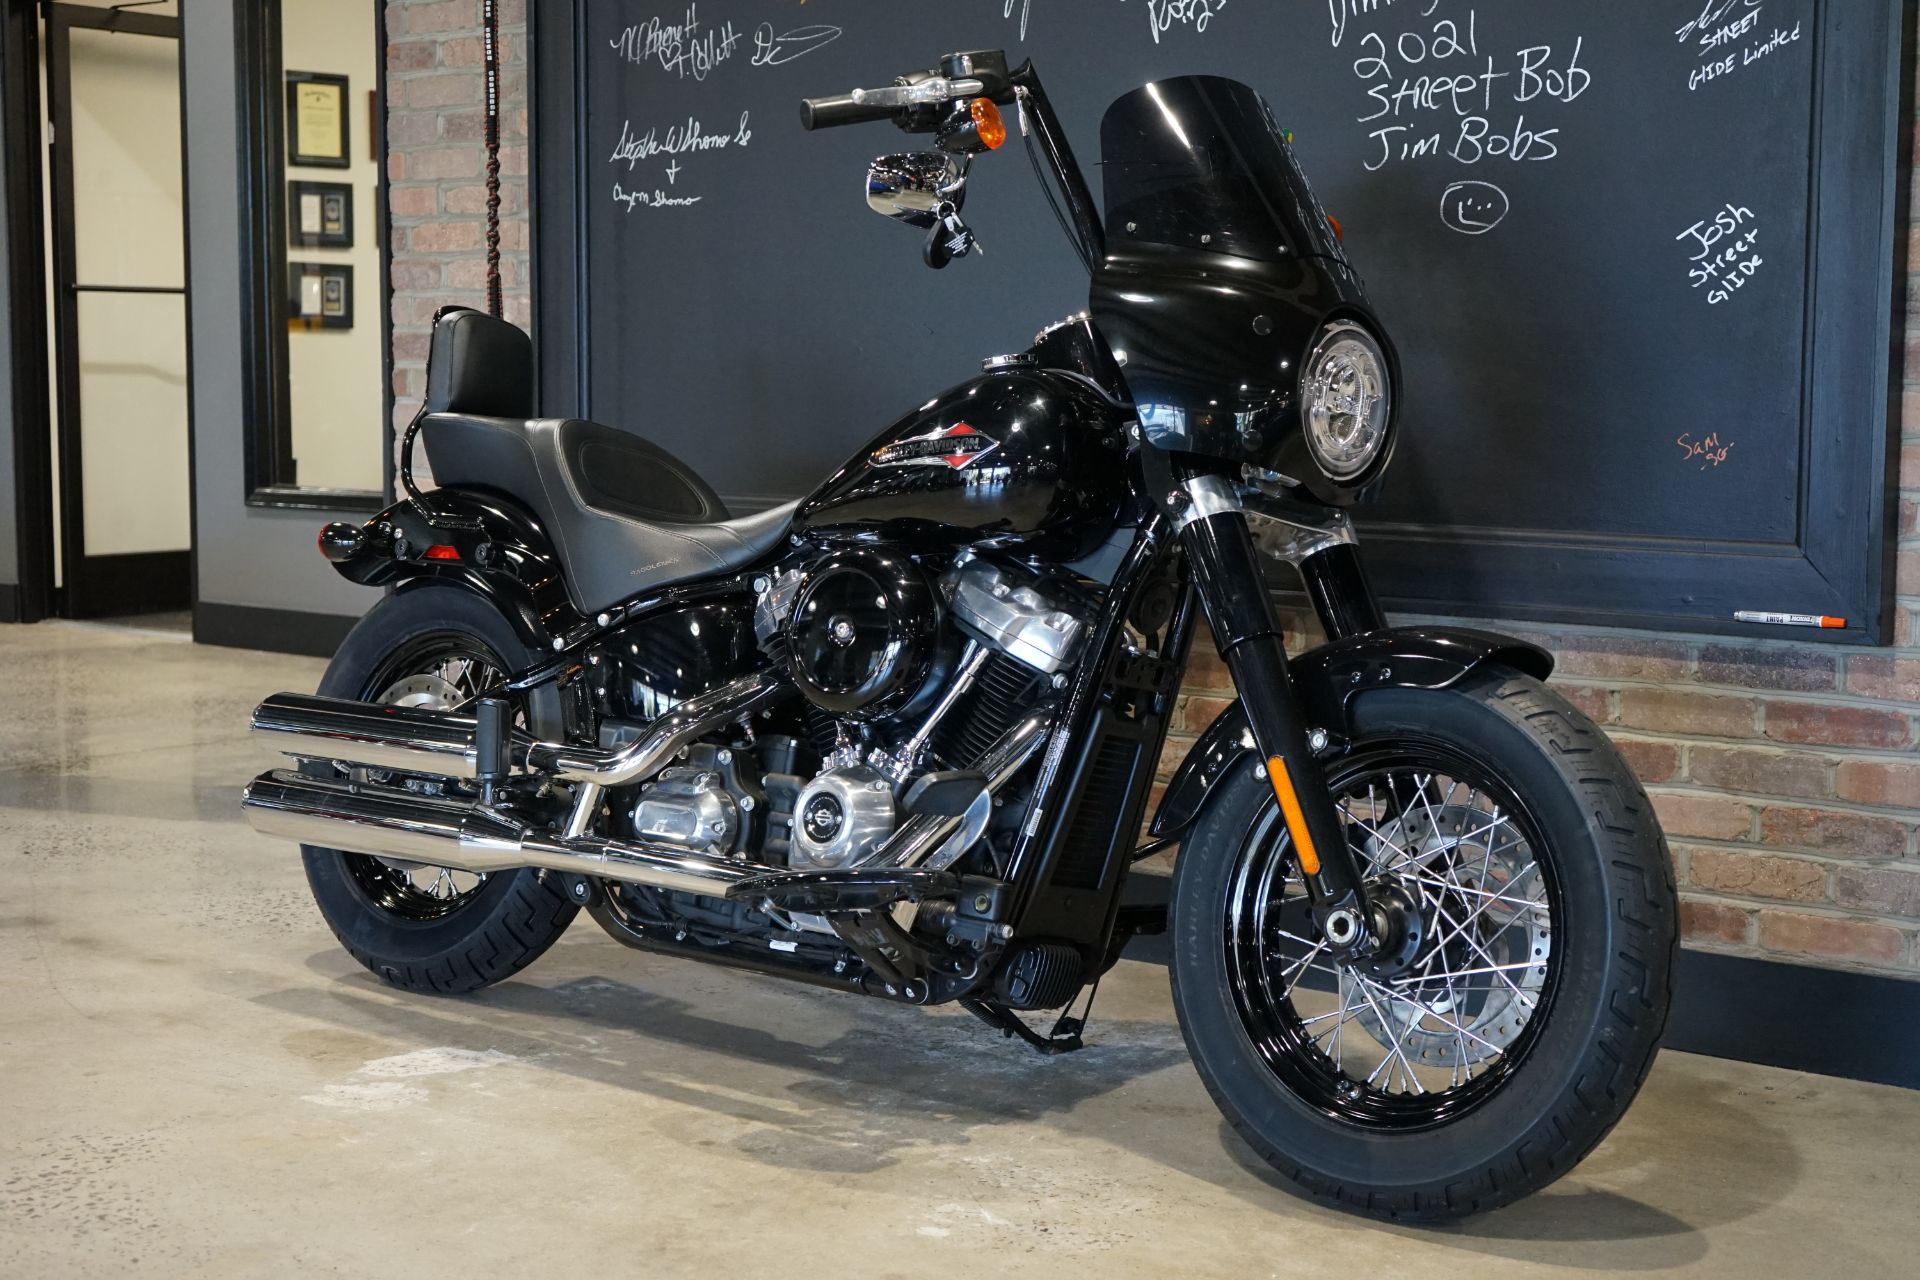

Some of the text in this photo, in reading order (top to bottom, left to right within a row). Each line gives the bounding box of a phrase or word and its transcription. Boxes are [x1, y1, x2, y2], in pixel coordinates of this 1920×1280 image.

[1353, 9, 1477, 80] 2021
[1513, 36, 1591, 103] Bob
[1743, 20, 1800, 66] Limited
[1363, 115, 1560, 171] Jim Bobs
[1675, 203, 1755, 261] Josh
[1688, 228, 1758, 288] Street
